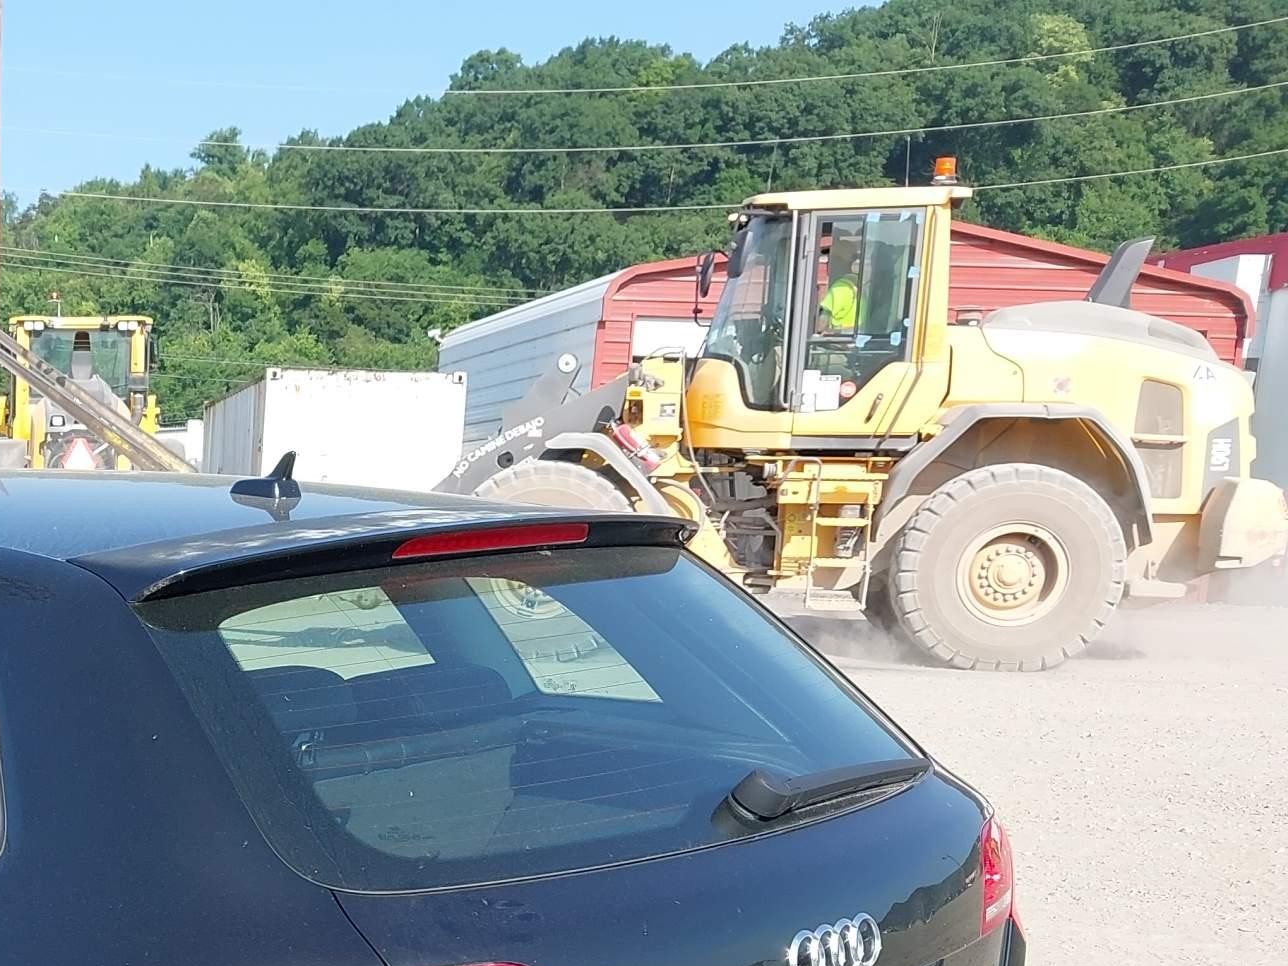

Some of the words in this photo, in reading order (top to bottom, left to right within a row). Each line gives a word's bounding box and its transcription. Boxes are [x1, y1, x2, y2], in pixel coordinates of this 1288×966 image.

[453, 460, 469, 478] NO
[505, 416, 544, 441] DEBAJO
[1209, 438, 1232, 472] L90H
